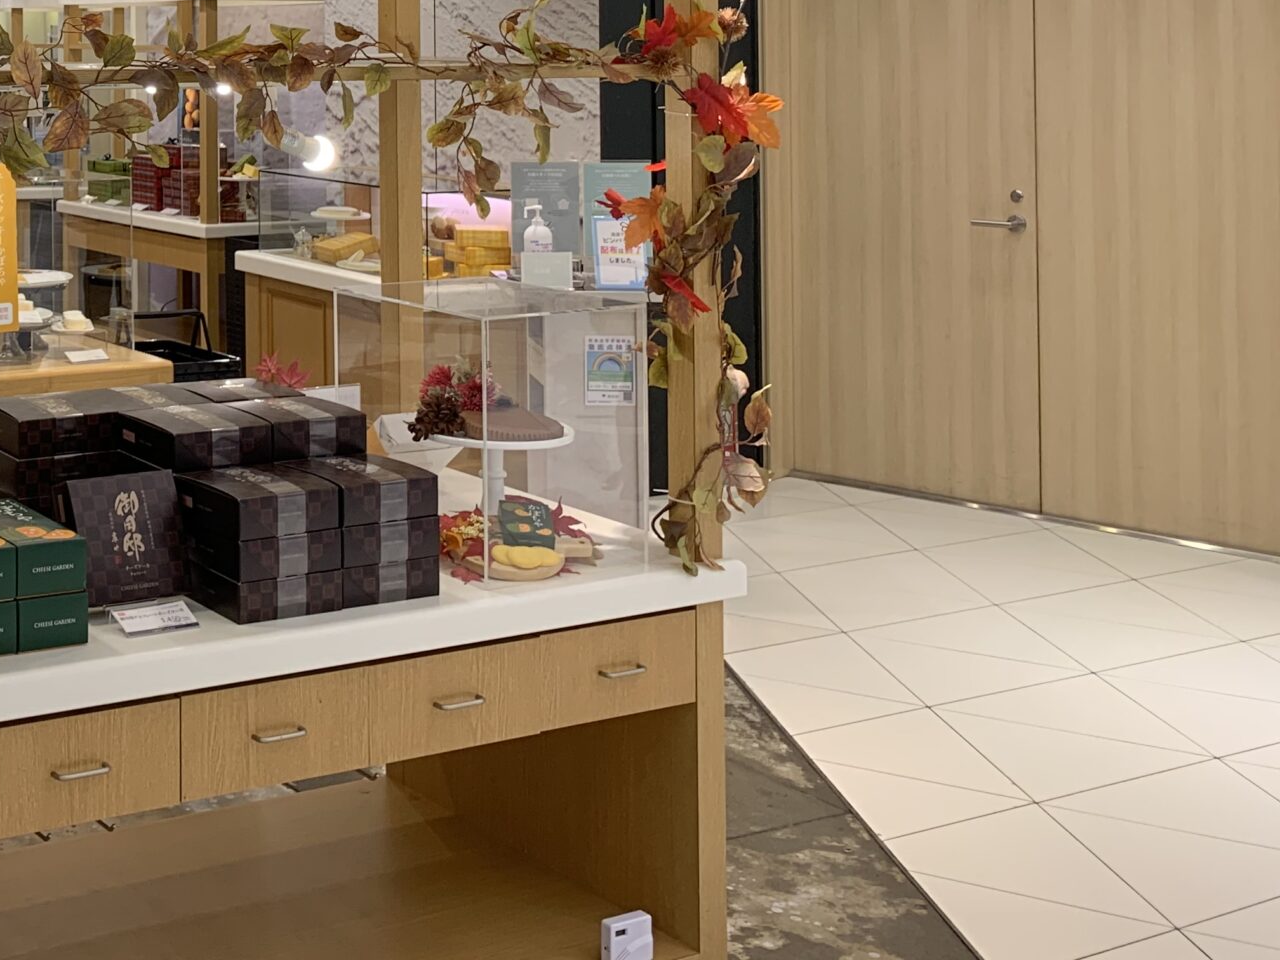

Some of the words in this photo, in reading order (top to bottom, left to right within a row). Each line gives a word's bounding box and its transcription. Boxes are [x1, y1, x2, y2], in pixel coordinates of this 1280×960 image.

[31, 565, 51, 574] CHEESE
[51, 562, 74, 572] GARDEN
[33, 620, 53, 629] CHEESE
[53, 617, 76, 626] GARDEN
